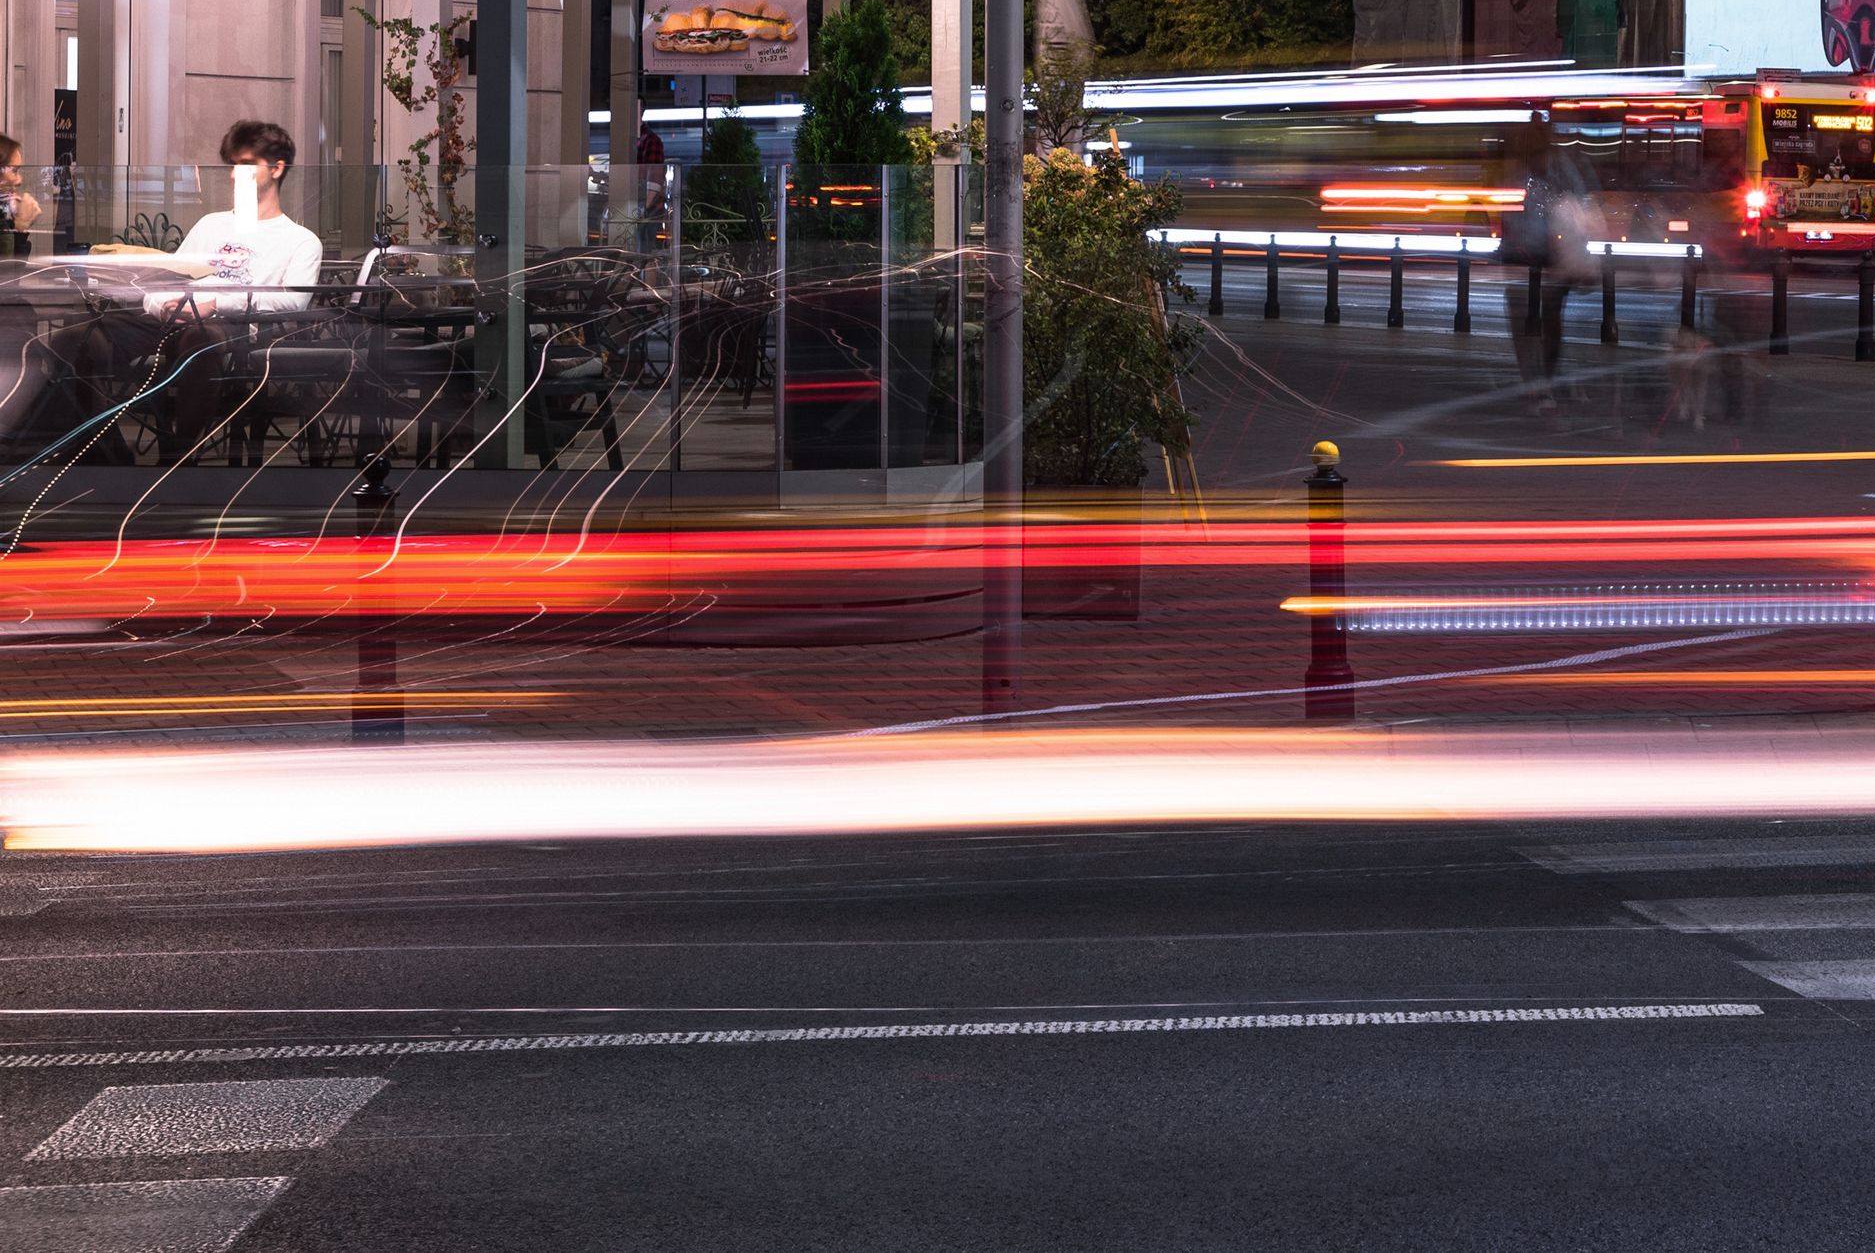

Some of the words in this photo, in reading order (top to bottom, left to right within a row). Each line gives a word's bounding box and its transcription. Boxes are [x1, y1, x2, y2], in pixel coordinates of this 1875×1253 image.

[757, 46, 788, 56] wielkość
[759, 55, 778, 63] 21-22
[1775, 108, 1798, 119] 9852
[1772, 119, 1798, 128] MOBILIS
[1855, 116, 1873, 131] 502
